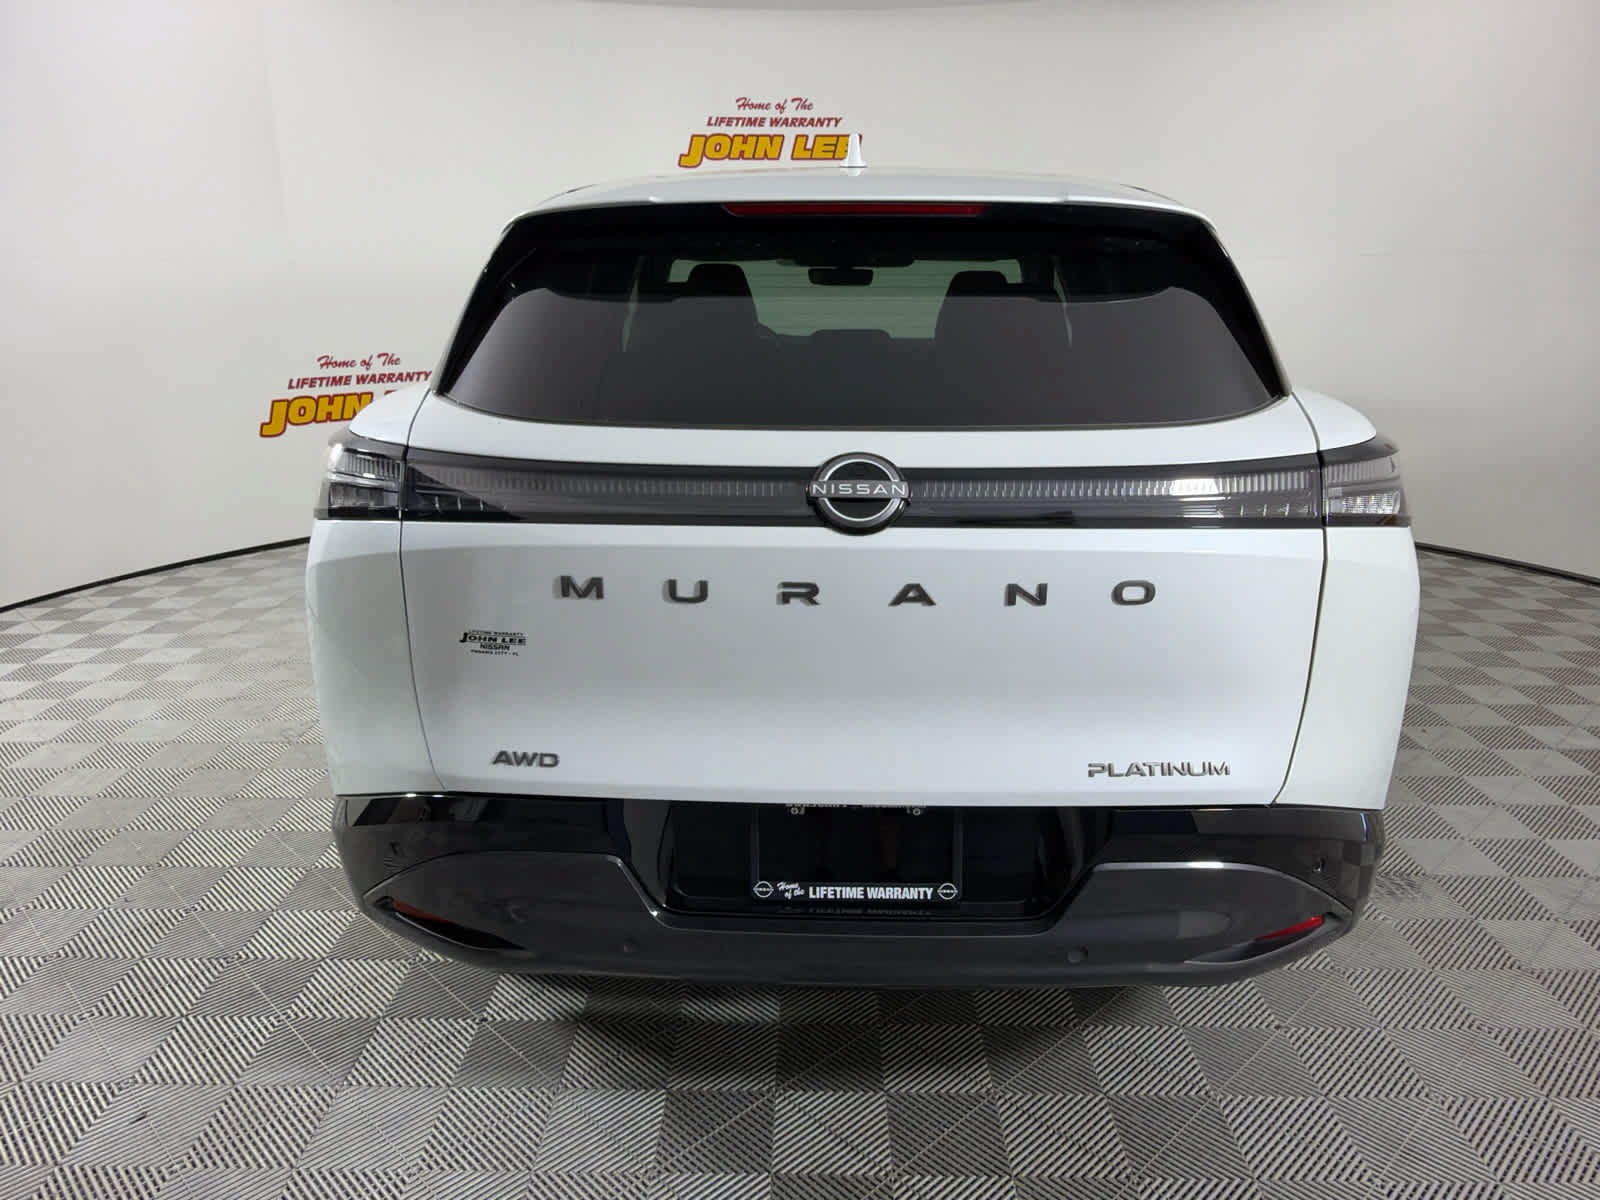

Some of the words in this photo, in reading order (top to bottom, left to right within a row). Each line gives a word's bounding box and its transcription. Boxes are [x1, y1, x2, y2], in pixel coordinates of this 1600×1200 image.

[736, 97, 771, 111] Home
[774, 99, 788, 114] of
[791, 97, 814, 111] The
[707, 116, 766, 128] LIFETIME
[769, 116, 842, 128] WARRANTY
[678, 134, 785, 168] JOHN
[317, 355, 358, 370] Home
[360, 354, 374, 371] of
[377, 353, 401, 367] The
[287, 374, 352, 390] LIFETIME
[355, 370, 433, 385] WARRANTY
[259, 392, 374, 438] JOHN
[812, 483, 906, 496] NISSAN
[554, 575, 1157, 607] MURANO
[459, 632, 497, 643] JOHN
[501, 637, 527, 645] LEE
[479, 643, 510, 651] NISSAN
[491, 750, 560, 768] AWD
[1087, 761, 1231, 778] PLATINUM
[777, 882, 801, 891] Home
[784, 889, 792, 900] of
[808, 886, 865, 899] LIFETIME
[866, 887, 933, 900] WARRANTY
